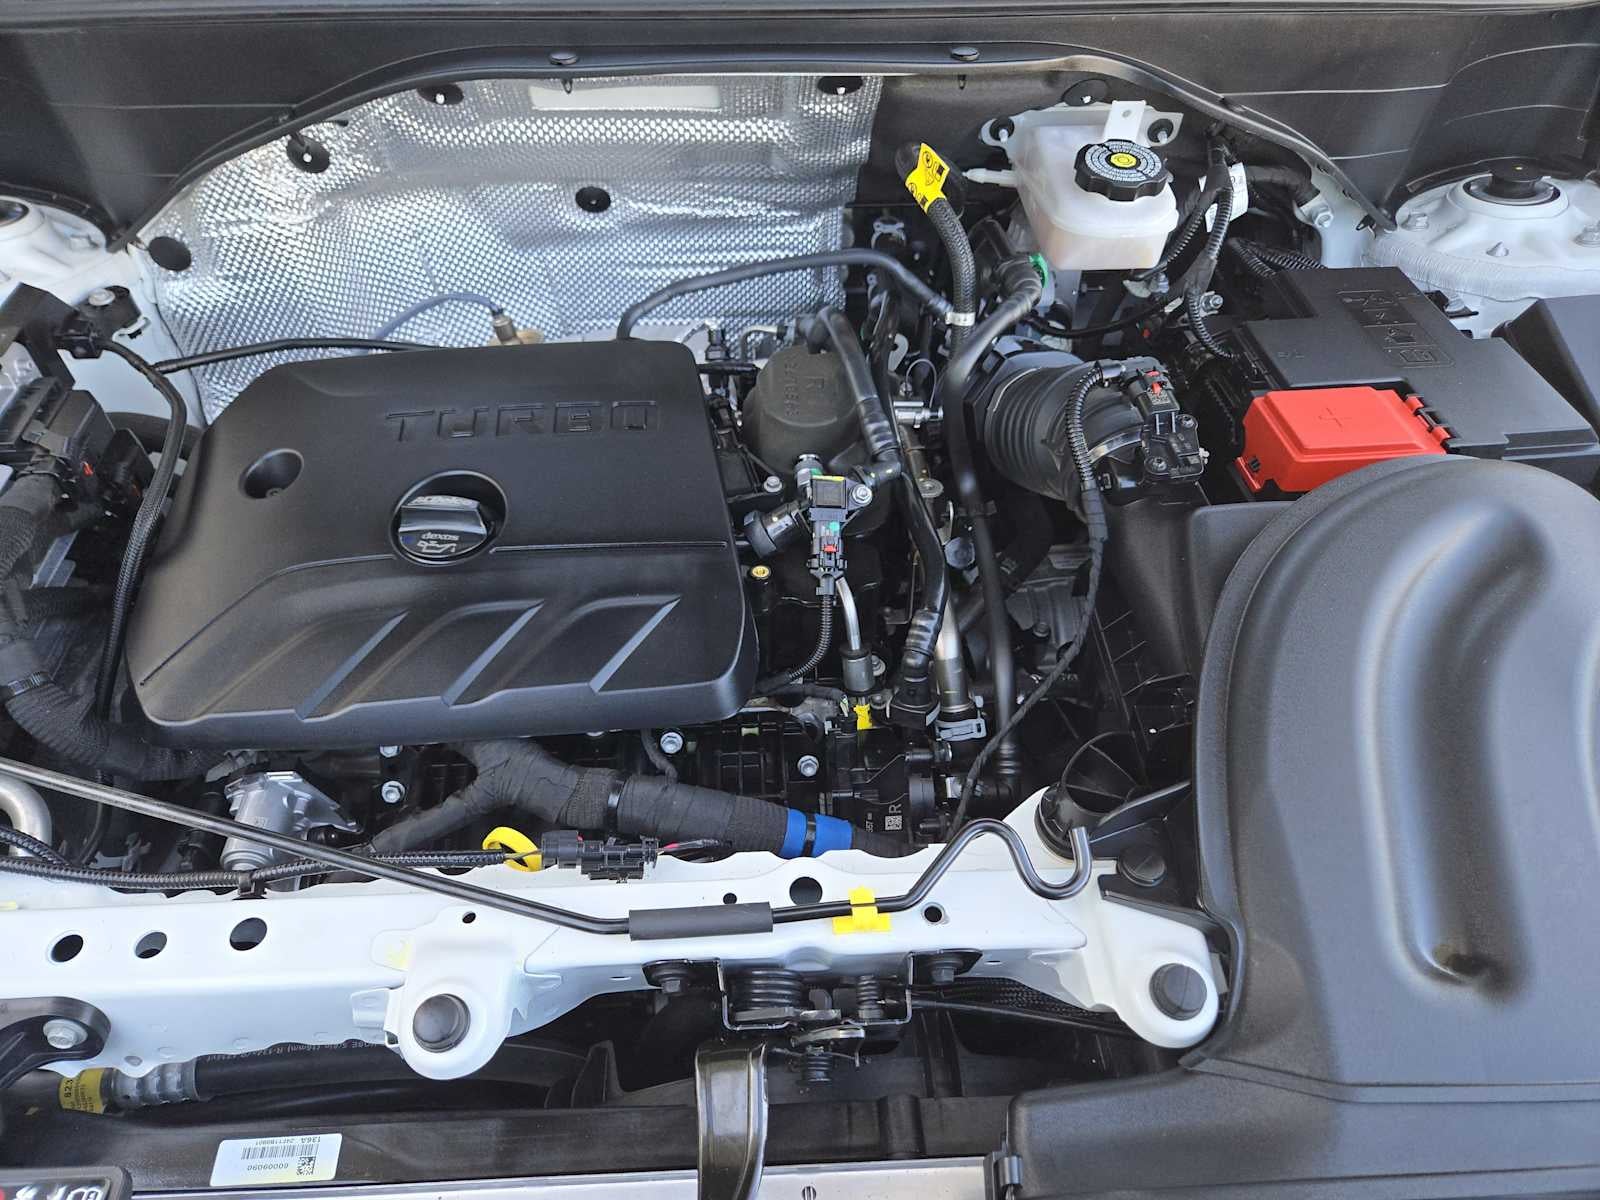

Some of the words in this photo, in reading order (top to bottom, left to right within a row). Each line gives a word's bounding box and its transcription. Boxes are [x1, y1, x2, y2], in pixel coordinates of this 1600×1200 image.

[385, 399, 659, 441] TURBO
[421, 532, 460, 541] dexos
[888, 803, 902, 814] R
